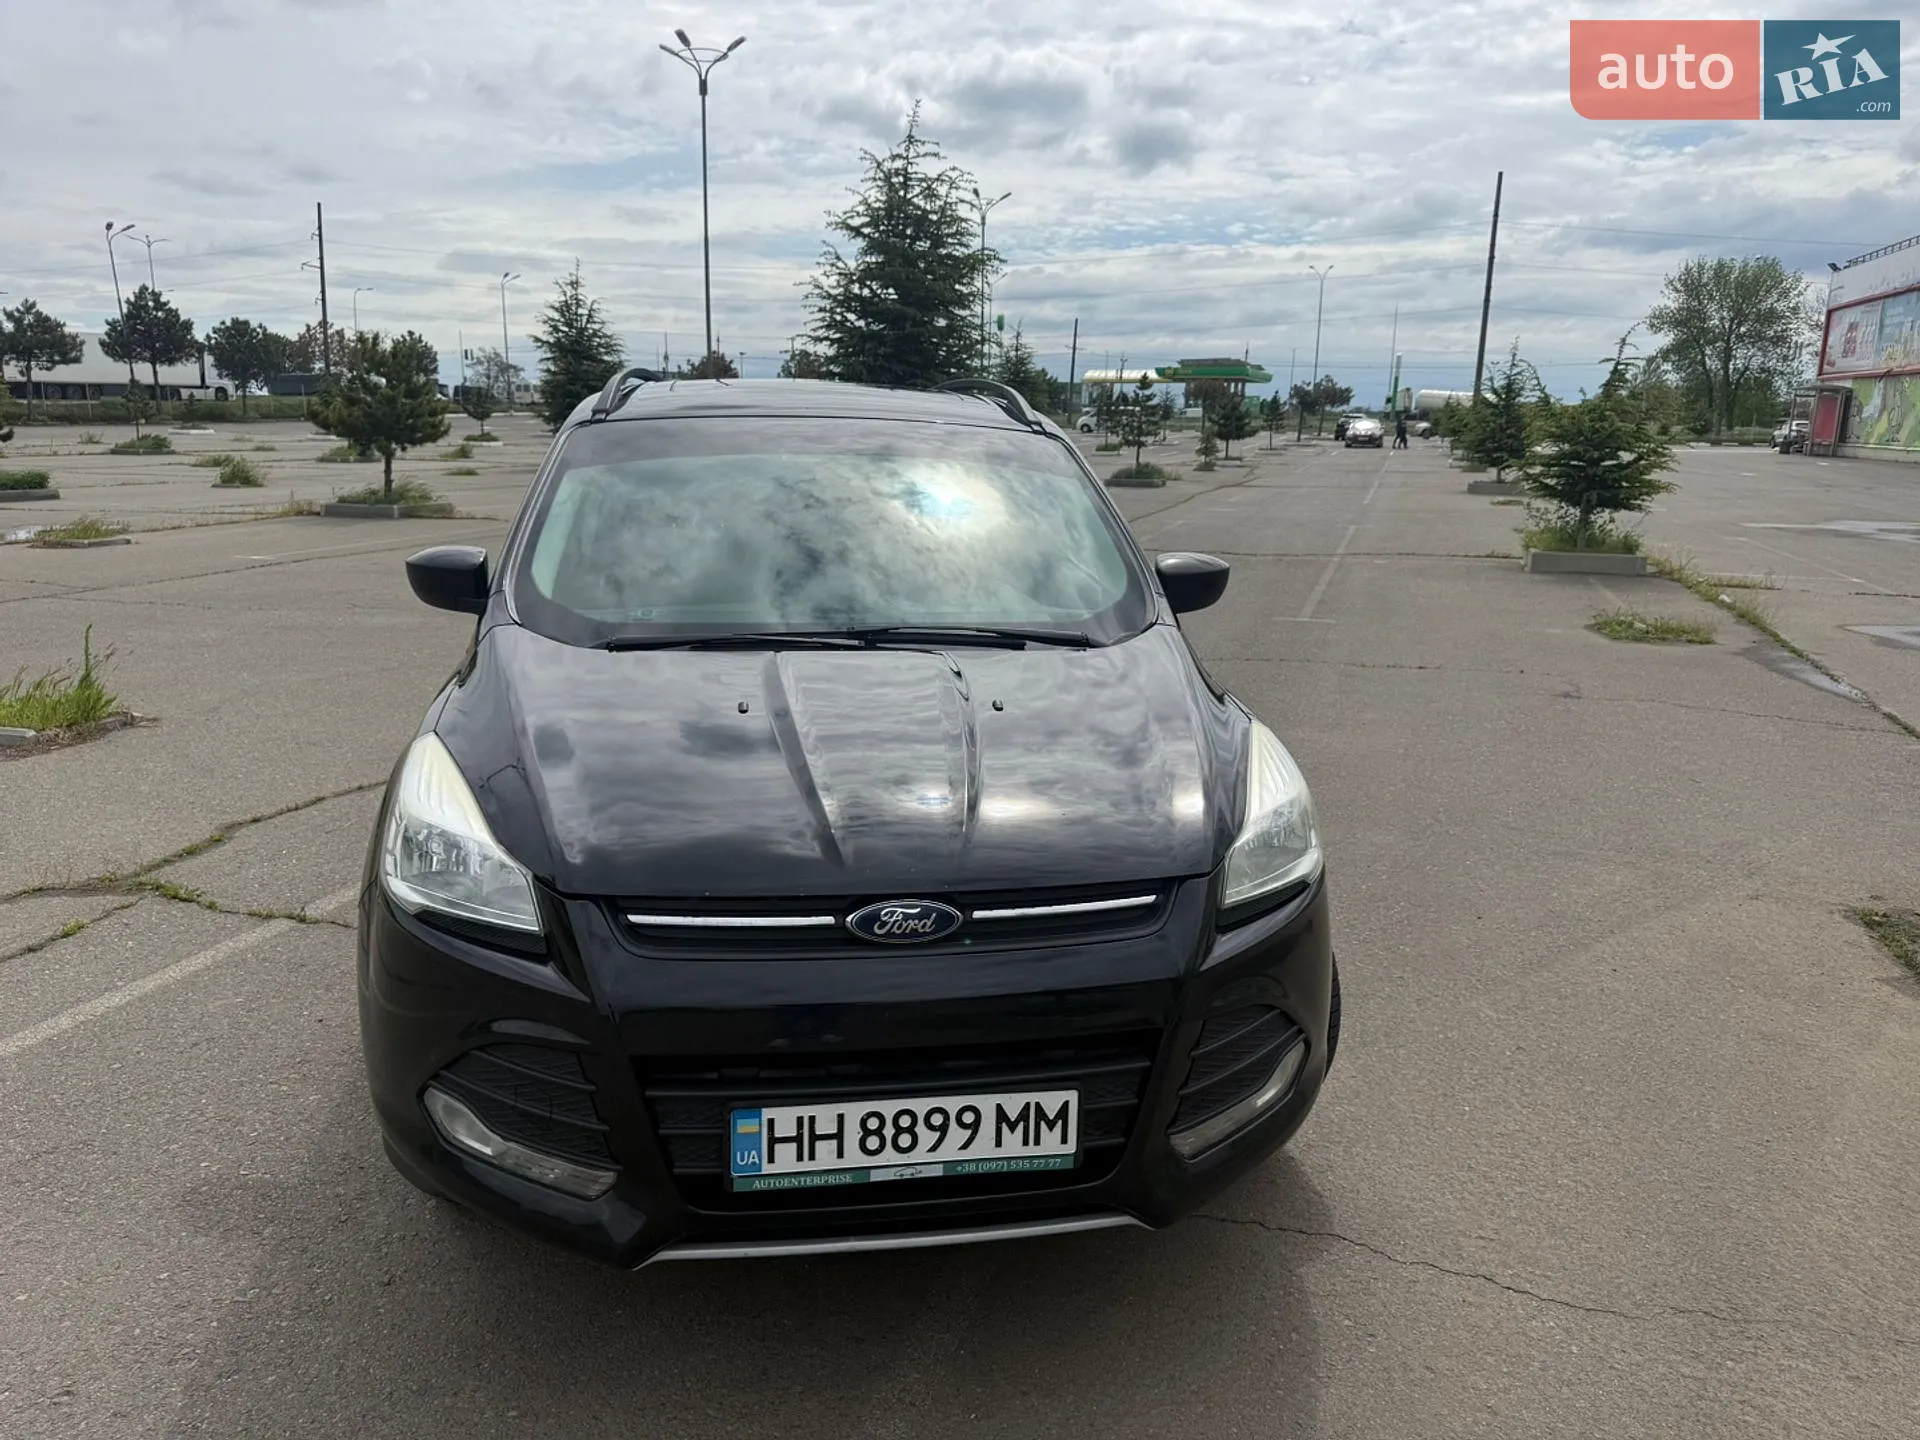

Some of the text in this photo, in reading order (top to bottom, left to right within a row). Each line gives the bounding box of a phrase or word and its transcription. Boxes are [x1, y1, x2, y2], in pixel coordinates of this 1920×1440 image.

[873, 907, 937, 935] Ford
[766, 1099, 1071, 1165] HH 8899 MM
[736, 1151, 760, 1166] UA
[956, 1162, 976, 1173] +38
[1010, 1159, 1030, 1170] 535
[1032, 1159, 1046, 1169] 77
[1048, 1158, 1062, 1168] 77
[752, 1173, 853, 1190] AUTOENTERPRISE
